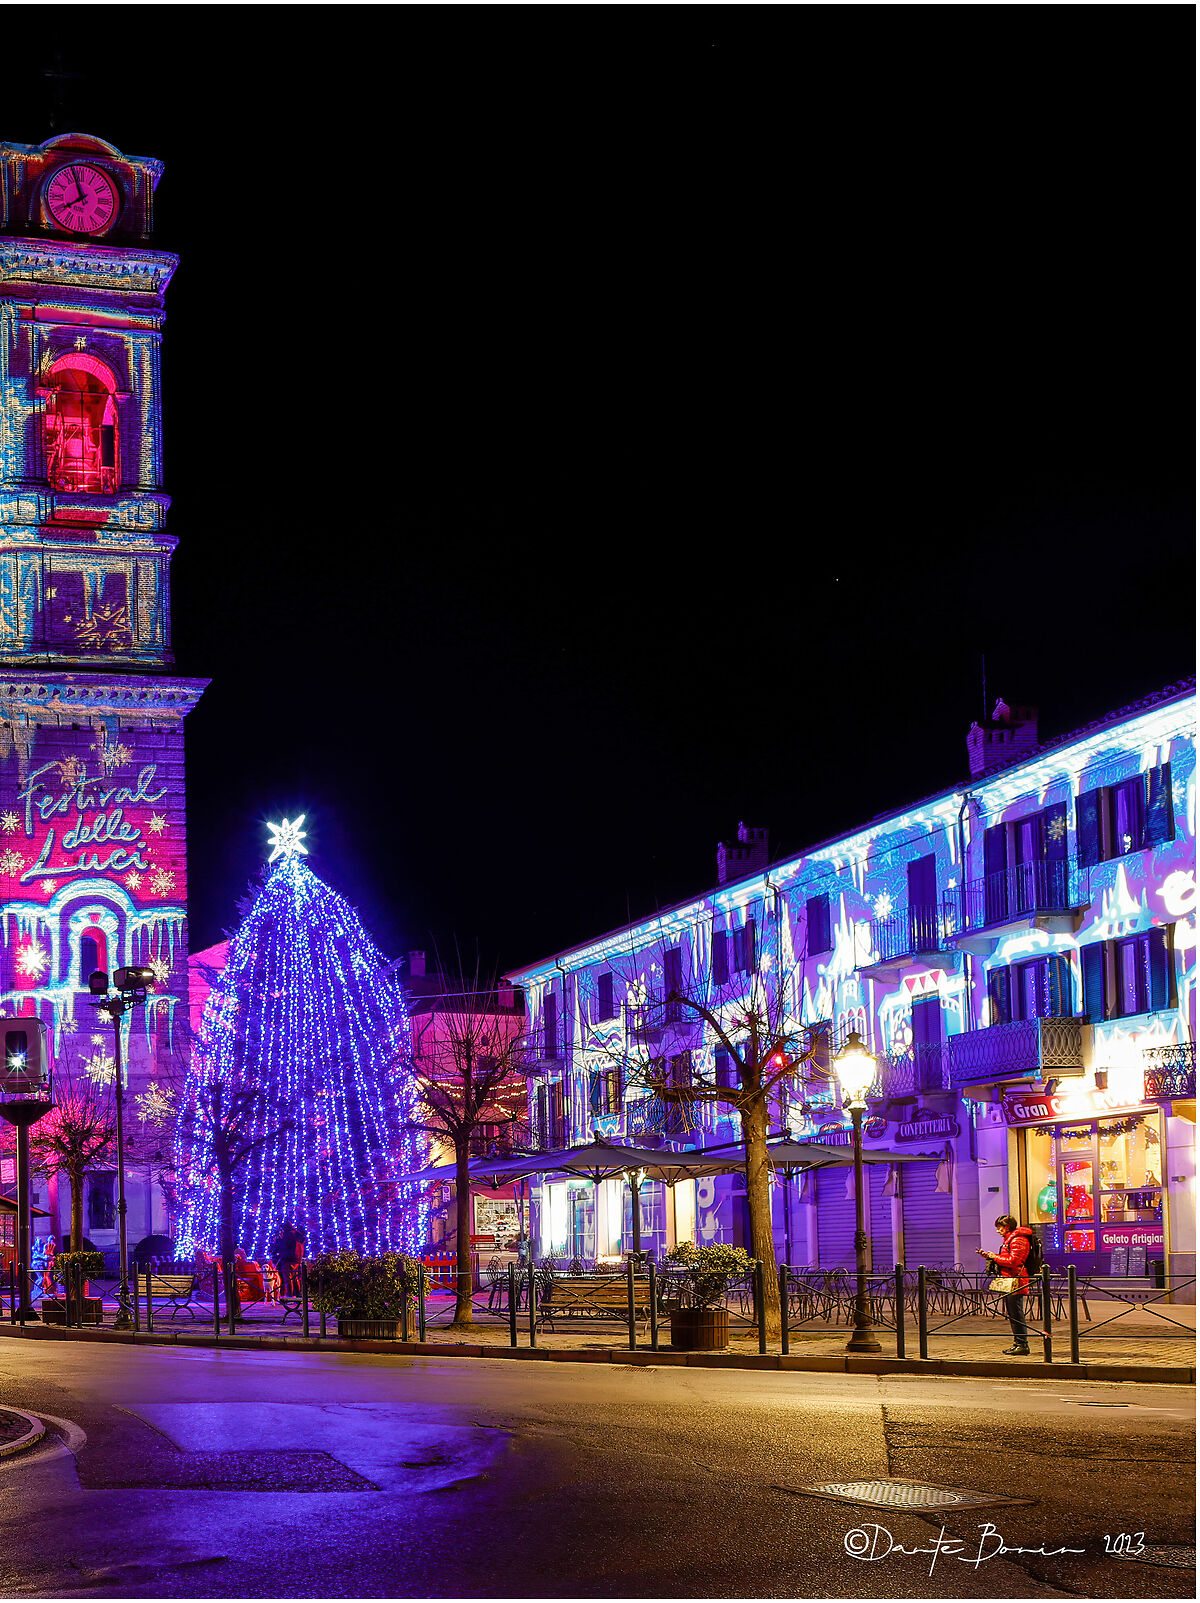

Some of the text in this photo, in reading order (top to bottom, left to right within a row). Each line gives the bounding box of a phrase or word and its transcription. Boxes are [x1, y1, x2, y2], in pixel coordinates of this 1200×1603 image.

[17, 761, 169, 835] Festival
[62, 808, 141, 849] delle
[20, 828, 150, 882] Luci
[1013, 1102, 1049, 1119] Gran
[900, 1118, 951, 1138] CONFETTERIA
[1102, 1233, 1129, 1245] Gelato
